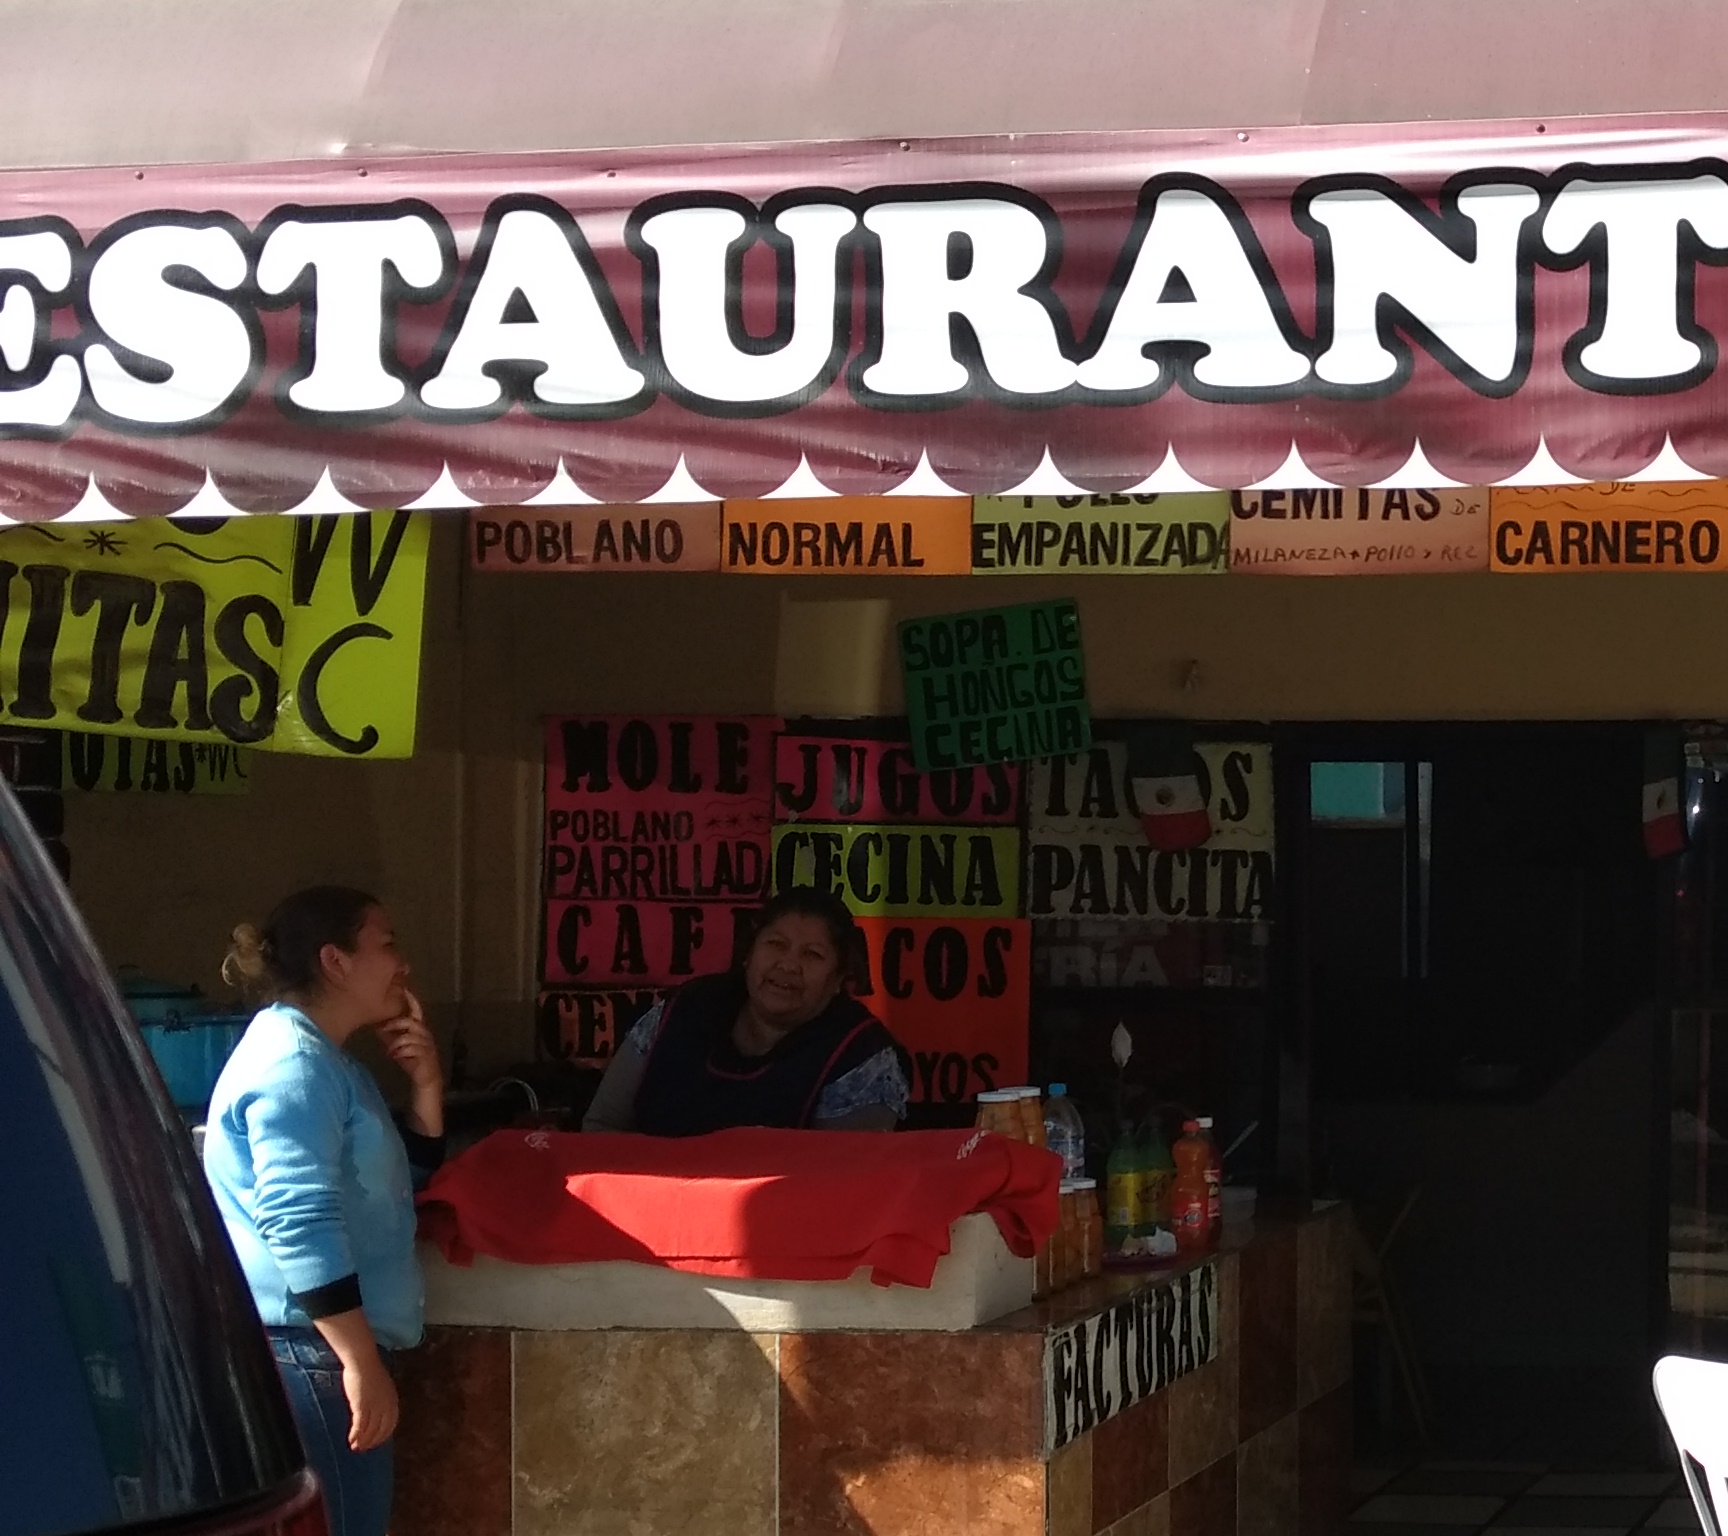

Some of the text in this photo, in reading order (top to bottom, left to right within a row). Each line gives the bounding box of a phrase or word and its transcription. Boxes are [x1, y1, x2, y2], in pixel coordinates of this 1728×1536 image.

[474, 516, 686, 565] POBLANO
[728, 521, 925, 568] NORMAL
[1494, 518, 1722, 567] CARNERO
[0, 561, 285, 744] ITAS
[1031, 604, 1080, 656] DE
[921, 655, 1085, 721] HONGOS
[561, 720, 750, 795] MOLE
[924, 705, 1082, 769] CECINA
[549, 809, 695, 843] POBLANO
[775, 831, 1004, 906] CECINA
[1030, 844, 1273, 916] PANCITA
[1052, 1263, 1216, 1448] FACTURAS
